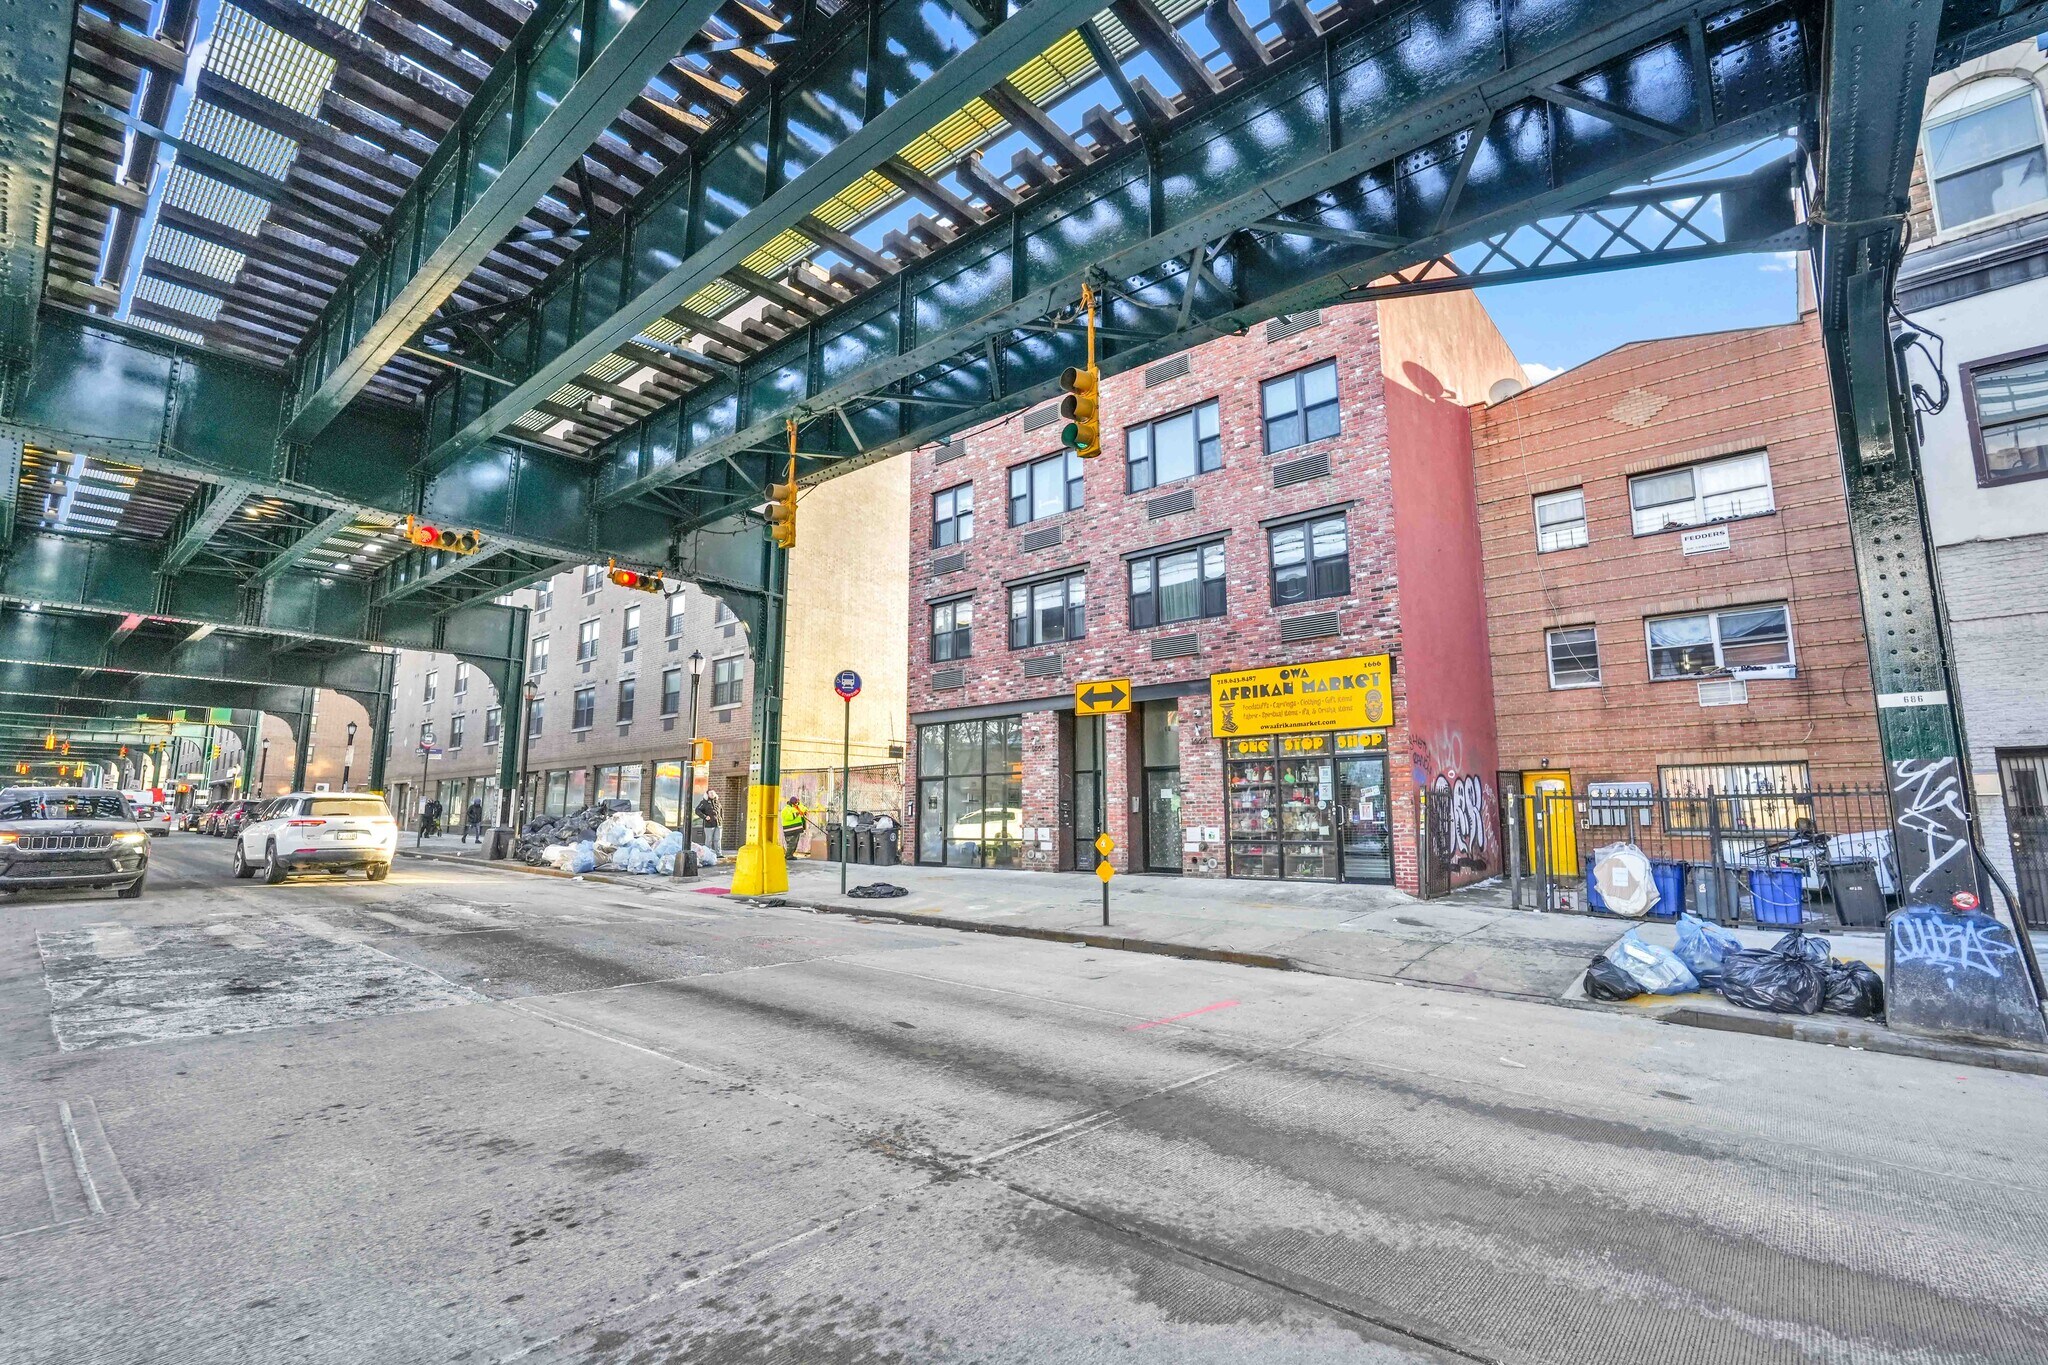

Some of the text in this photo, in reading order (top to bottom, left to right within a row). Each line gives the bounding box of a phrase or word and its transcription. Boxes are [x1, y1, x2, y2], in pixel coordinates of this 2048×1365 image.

[1684, 530, 1726, 541] FEDDERS
[1279, 668, 1309, 680] OWA
[1219, 672, 1381, 701] AFRIKAN MARKET
[1903, 694, 1924, 703] 686
[1260, 720, 1337, 730] owaafrikanmarket.com
[1238, 733, 1382, 753] ONE STOP SHOP
